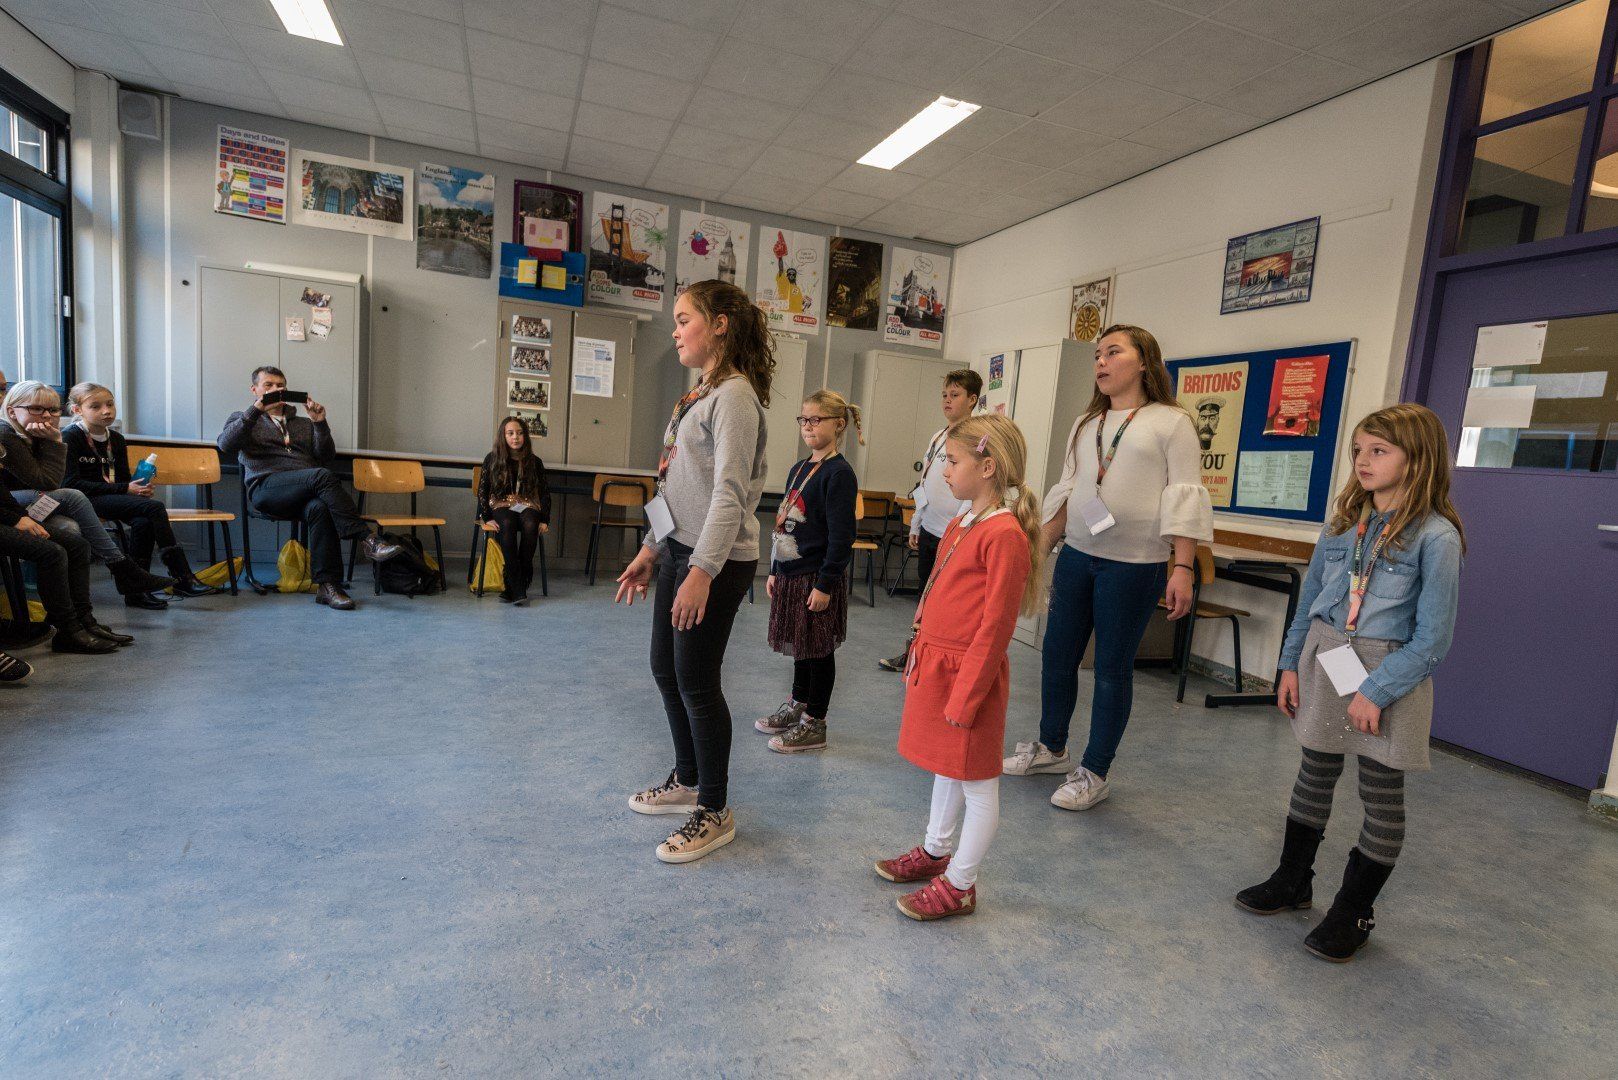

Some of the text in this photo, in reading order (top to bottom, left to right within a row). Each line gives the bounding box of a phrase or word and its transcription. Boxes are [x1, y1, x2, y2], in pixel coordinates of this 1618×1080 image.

[220, 126, 242, 138] Days
[243, 132, 259, 141] and
[261, 135, 286, 147] Dates
[590, 284, 622, 296] COLOUR
[886, 327, 911, 337] COLOUR
[1182, 370, 1243, 394] BRITONS
